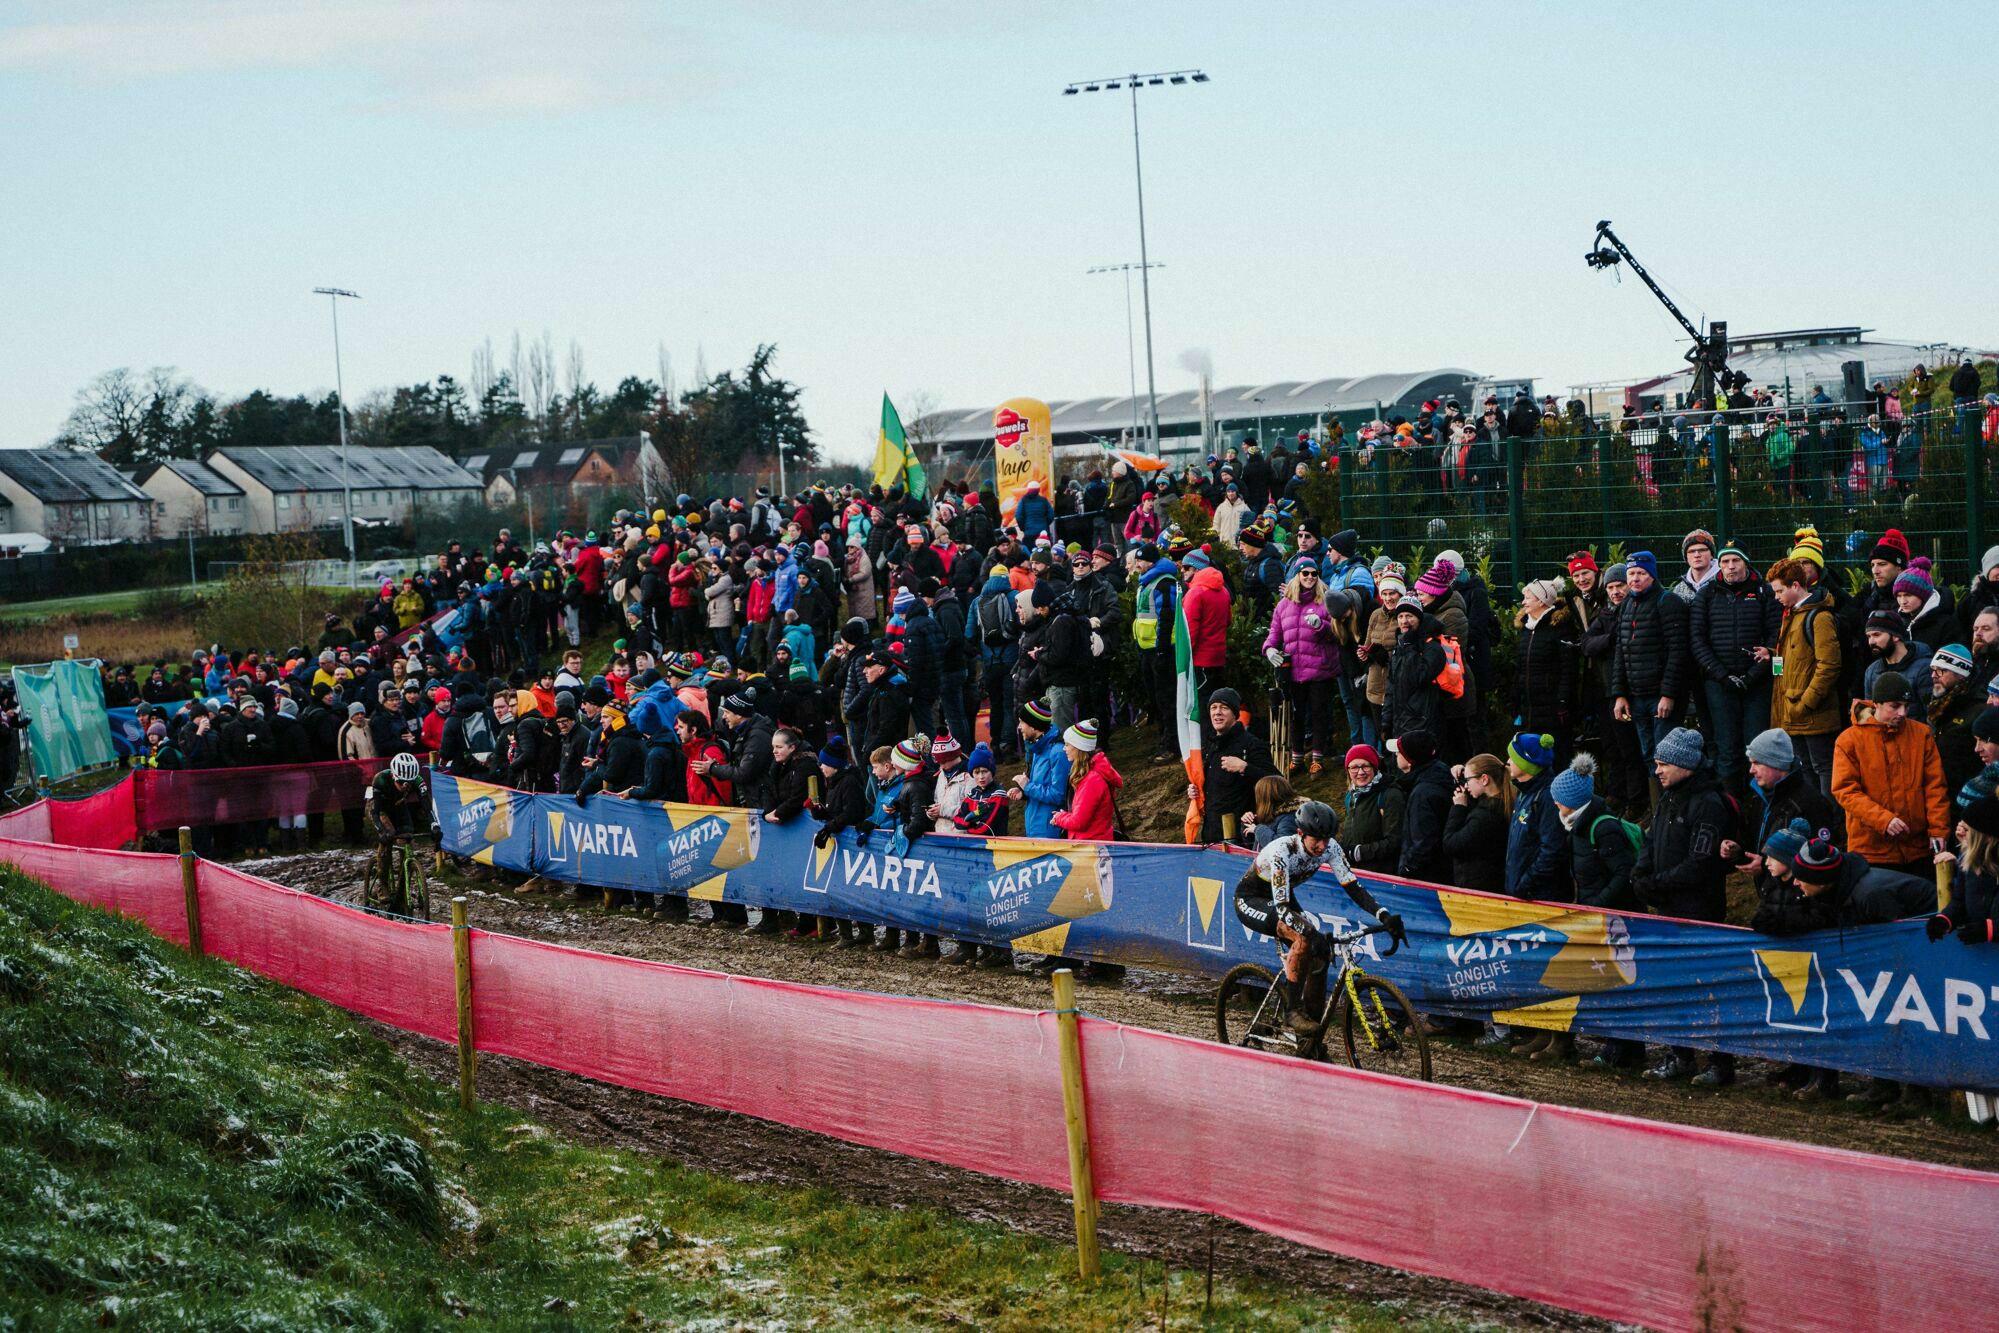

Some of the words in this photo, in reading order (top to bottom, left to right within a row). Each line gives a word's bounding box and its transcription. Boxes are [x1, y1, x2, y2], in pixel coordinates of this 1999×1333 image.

[457, 799, 493, 829] VARTA
[568, 821, 639, 859] VARTA
[667, 818, 724, 857] VARTA
[668, 848, 700, 872] LONGLIFE
[670, 864, 692, 881] POWER
[842, 849, 943, 899] VARTA
[987, 858, 1063, 901] VARTA
[985, 892, 1031, 917] LONGLIFE
[1237, 898, 1268, 922] SRAM
[986, 910, 1020, 929] POWER
[1446, 959, 1511, 988] LONGLIFE
[1451, 980, 1498, 1001] POWER
